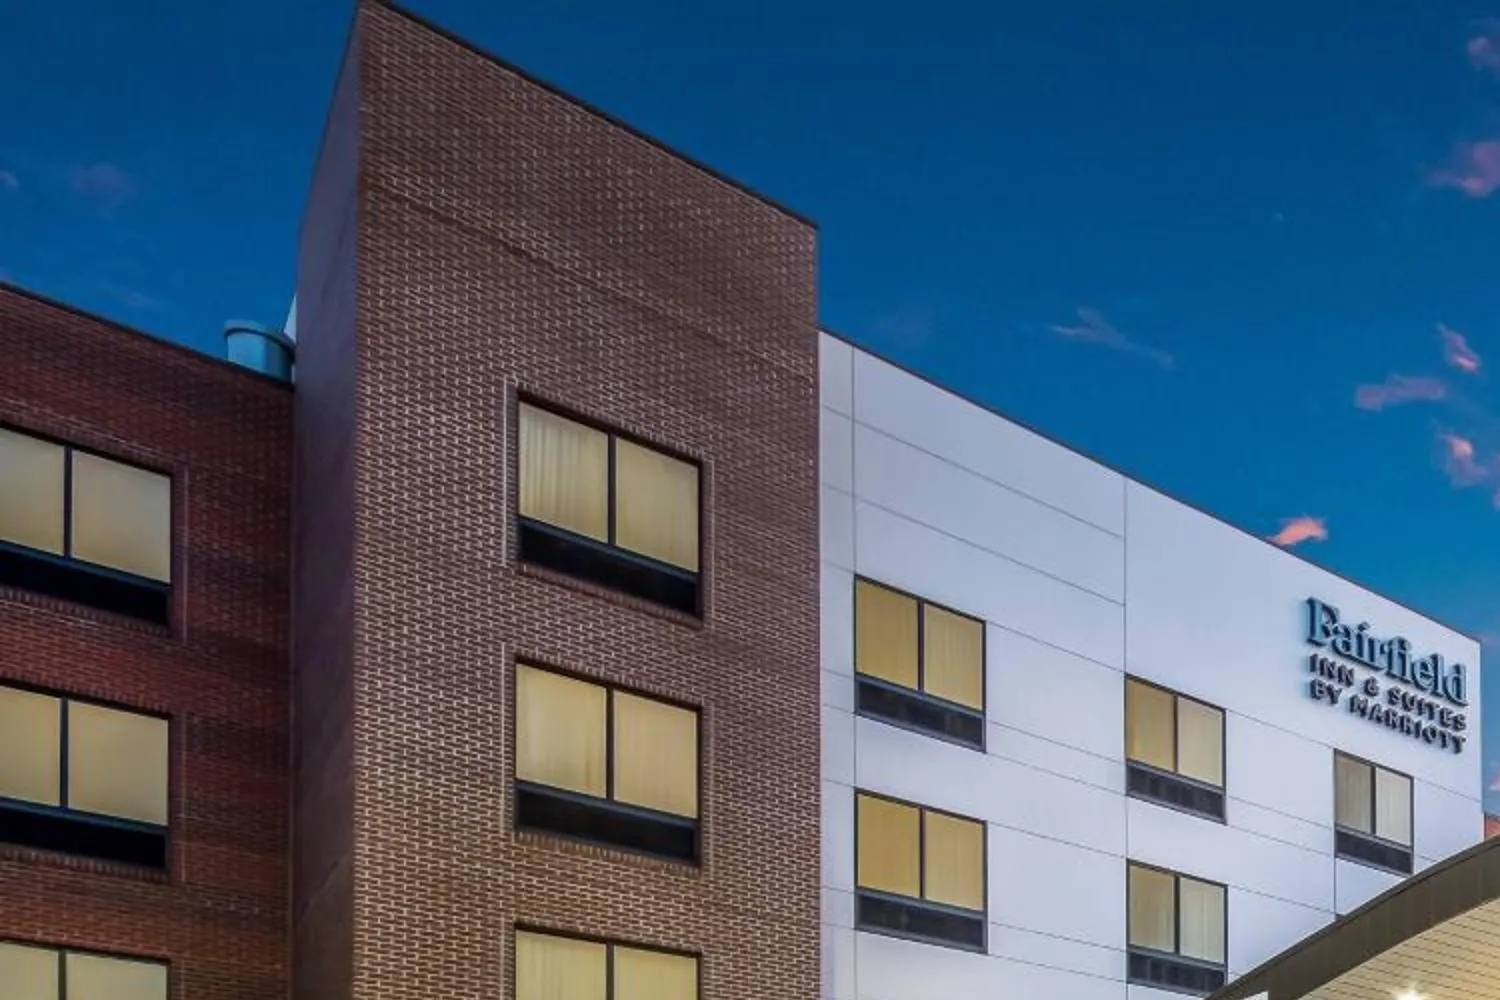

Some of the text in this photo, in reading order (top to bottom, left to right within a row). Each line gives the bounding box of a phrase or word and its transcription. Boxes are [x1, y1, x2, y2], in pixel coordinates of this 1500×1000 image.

[1305, 596, 1468, 706] Fairfield
[1308, 653, 1466, 732] INN & SUITES
[1310, 678, 1467, 754] BY MARRIOTT
